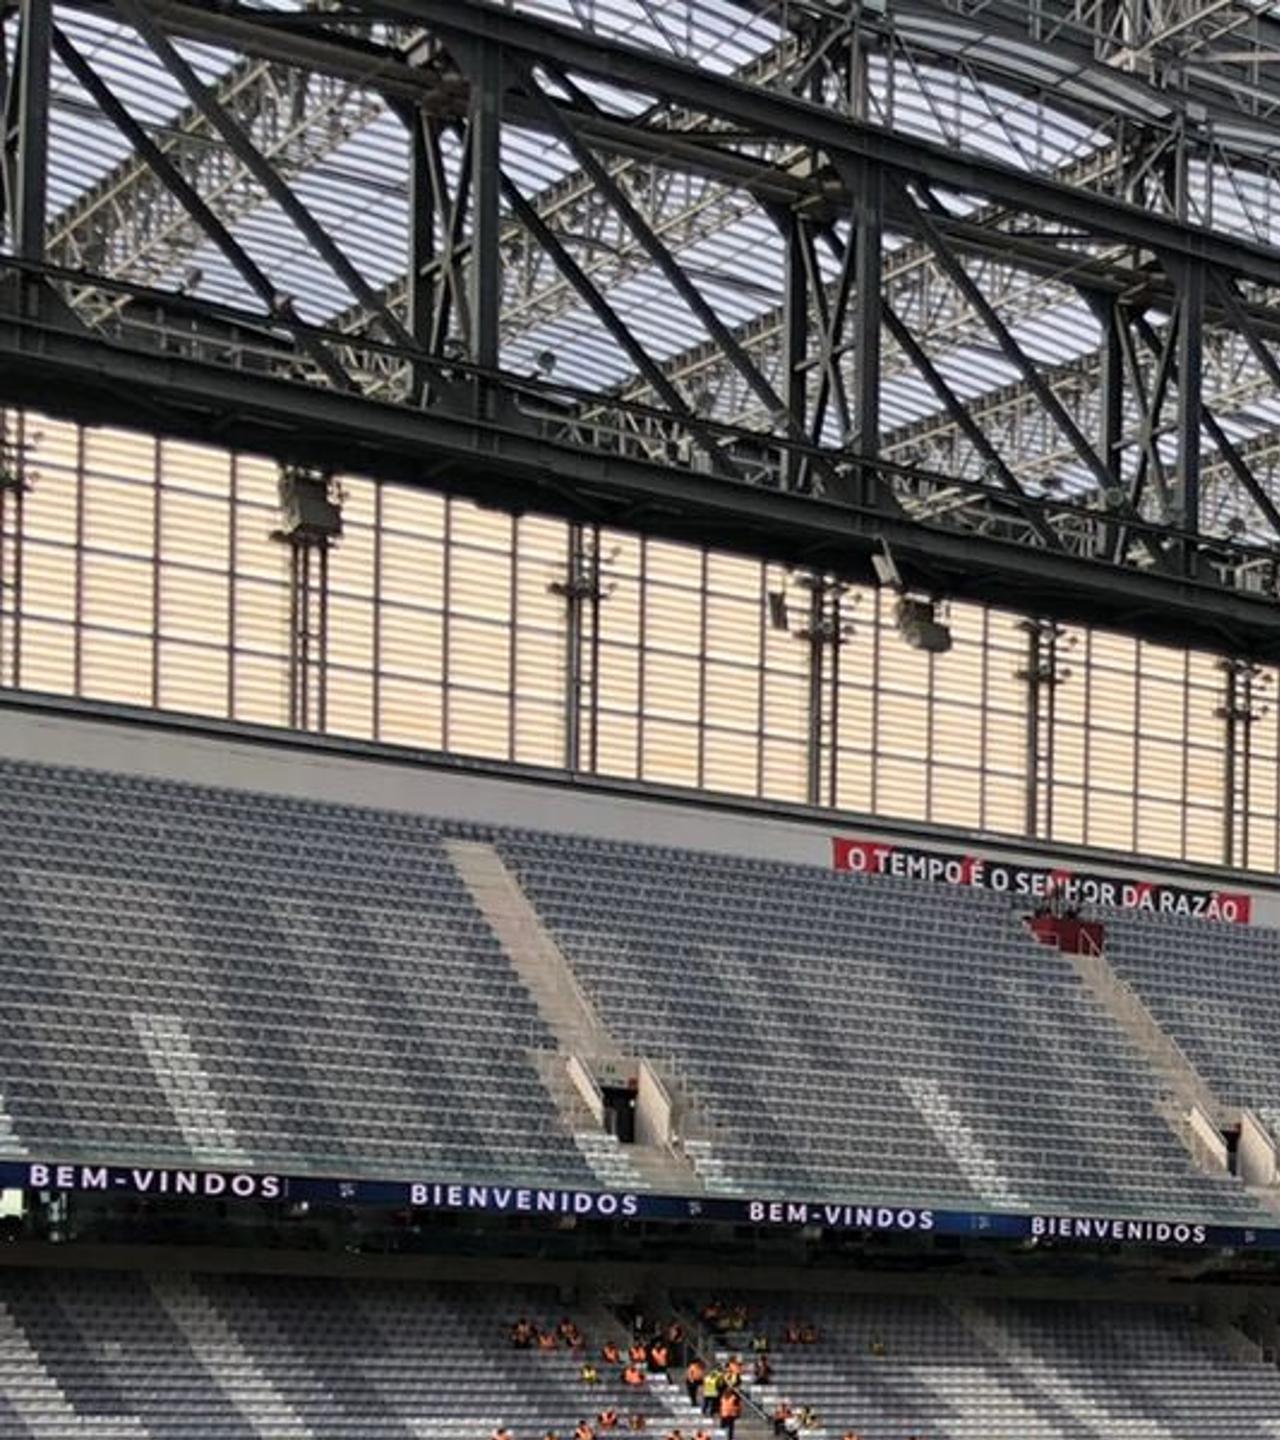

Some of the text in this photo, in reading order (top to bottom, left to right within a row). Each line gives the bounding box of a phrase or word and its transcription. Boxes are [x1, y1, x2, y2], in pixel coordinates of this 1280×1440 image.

[848, 847, 866, 872] O
[874, 849, 962, 885] TEMPO
[970, 859, 984, 888] É
[991, 873, 1009, 892] O
[1122, 889, 1154, 911] DA
[1159, 891, 1237, 922] RAZÃO
[29, 1165, 281, 1197] BEM-VINDOS
[410, 1184, 639, 1215] BIENVENIDOS
[750, 1202, 934, 1229] BEM-VINDOS
[1031, 1217, 1206, 1243] BIENVENIDOS
